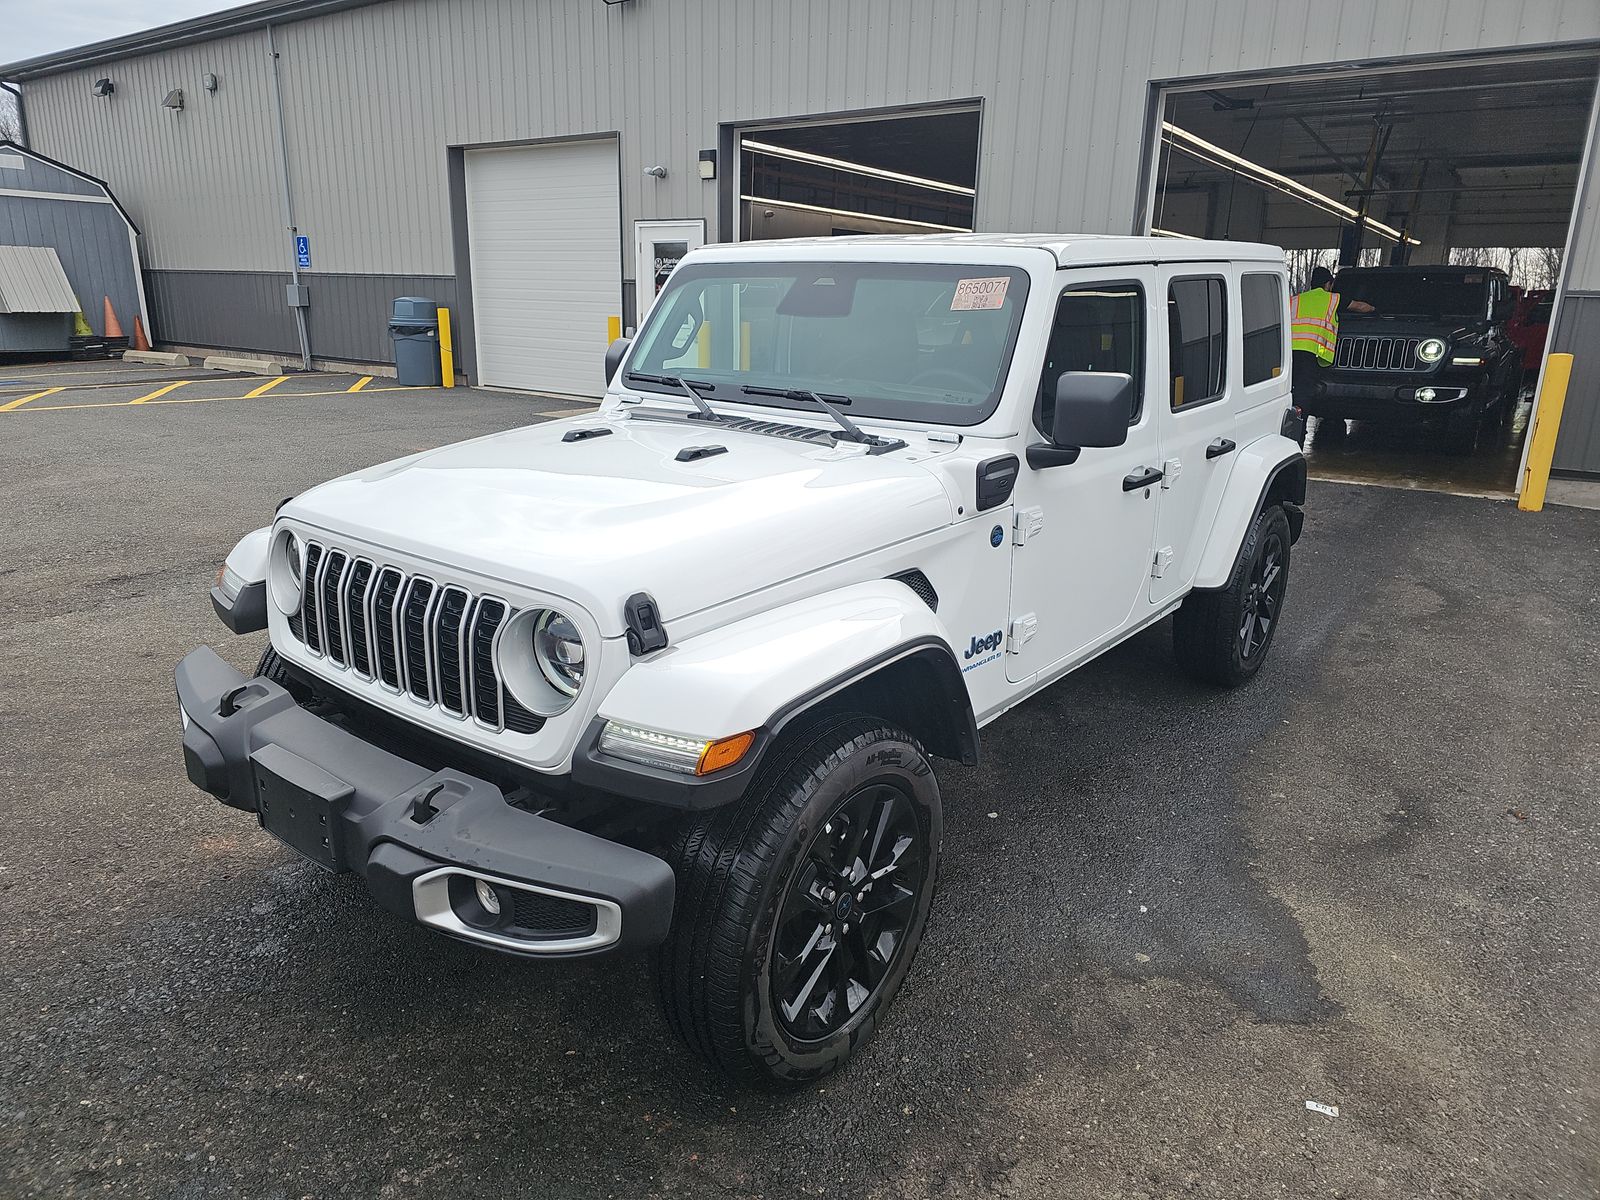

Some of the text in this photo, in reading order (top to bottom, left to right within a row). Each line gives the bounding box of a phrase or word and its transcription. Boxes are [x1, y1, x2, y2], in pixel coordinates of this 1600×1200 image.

[958, 281, 1007, 295] 8650071
[964, 630, 1003, 660] Jeep
[962, 655, 996, 673] WRANGLER
